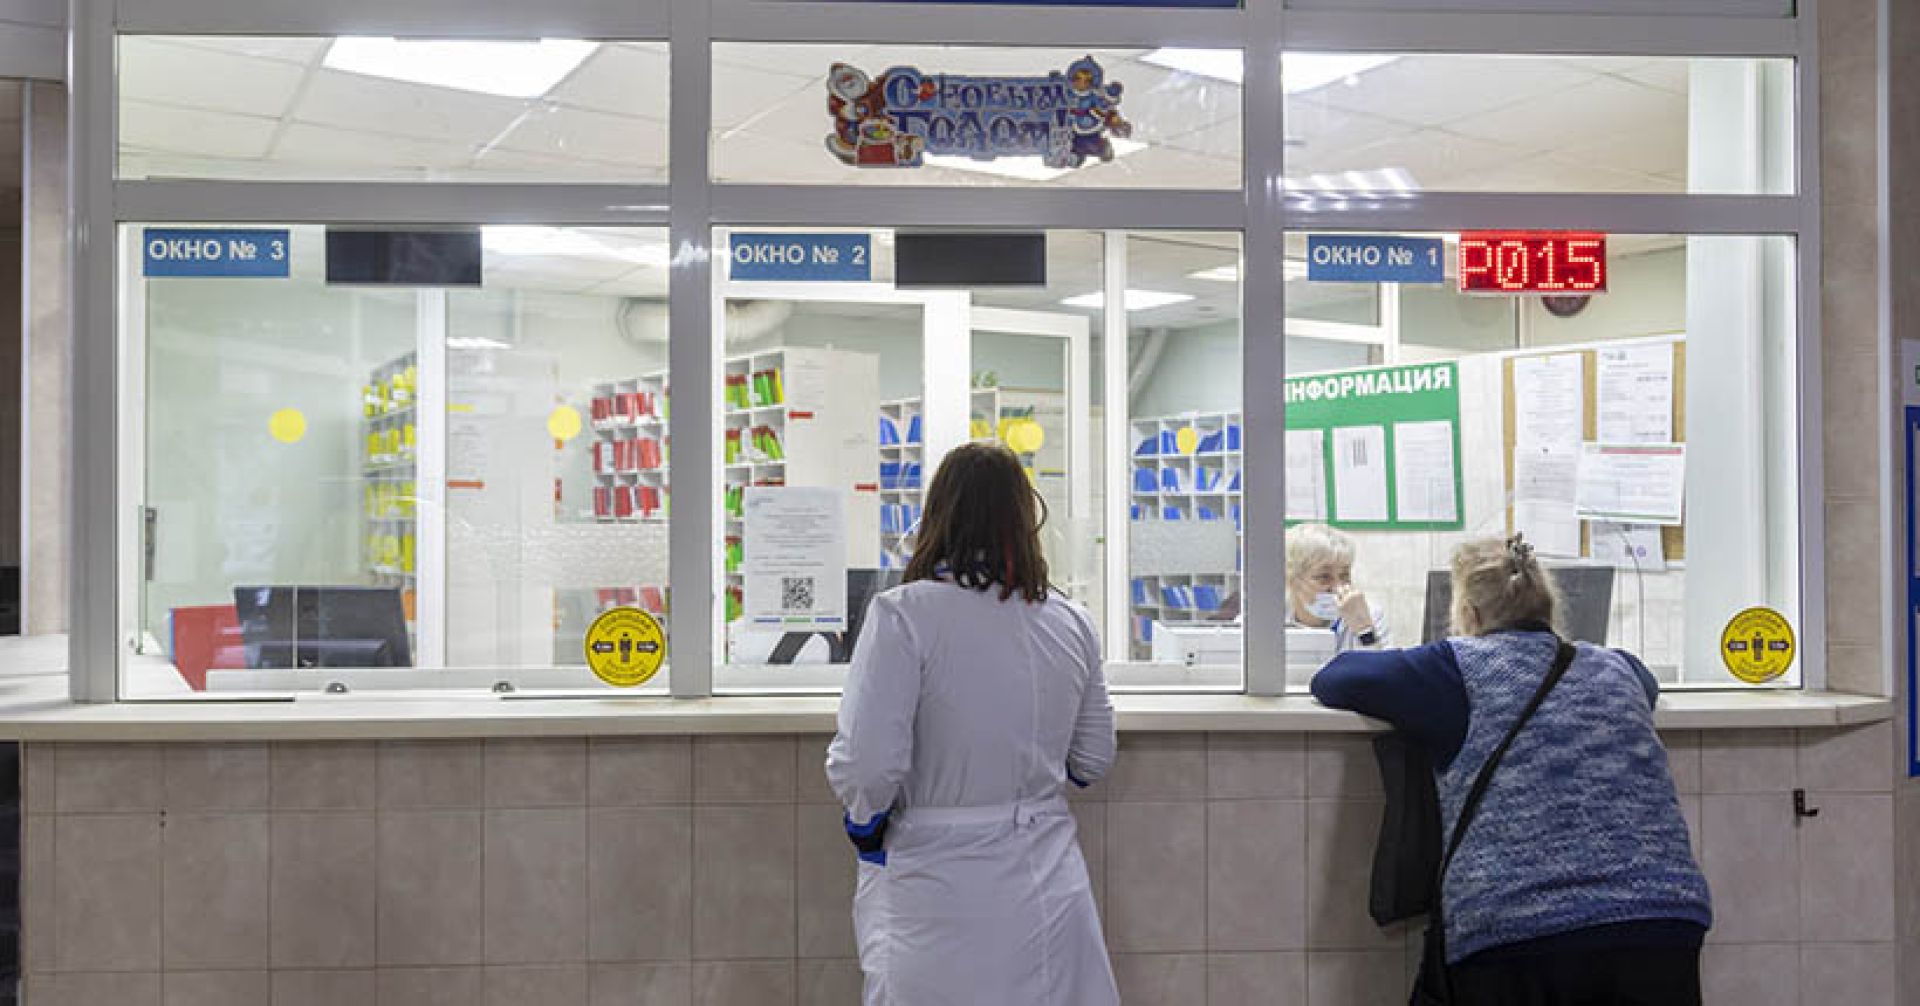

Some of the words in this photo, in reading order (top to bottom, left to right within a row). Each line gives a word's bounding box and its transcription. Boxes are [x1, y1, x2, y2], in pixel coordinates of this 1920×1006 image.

[149, 239, 221, 261] ОКНО
[228, 240, 256, 260] №
[270, 240, 284, 261] 3
[734, 243, 805, 265] ОКНО
[811, 245, 839, 263] №
[851, 245, 866, 265] 2
[1312, 245, 1380, 266] ОКНО
[1387, 246, 1413, 265] №
[1426, 247, 1438, 266] 1
